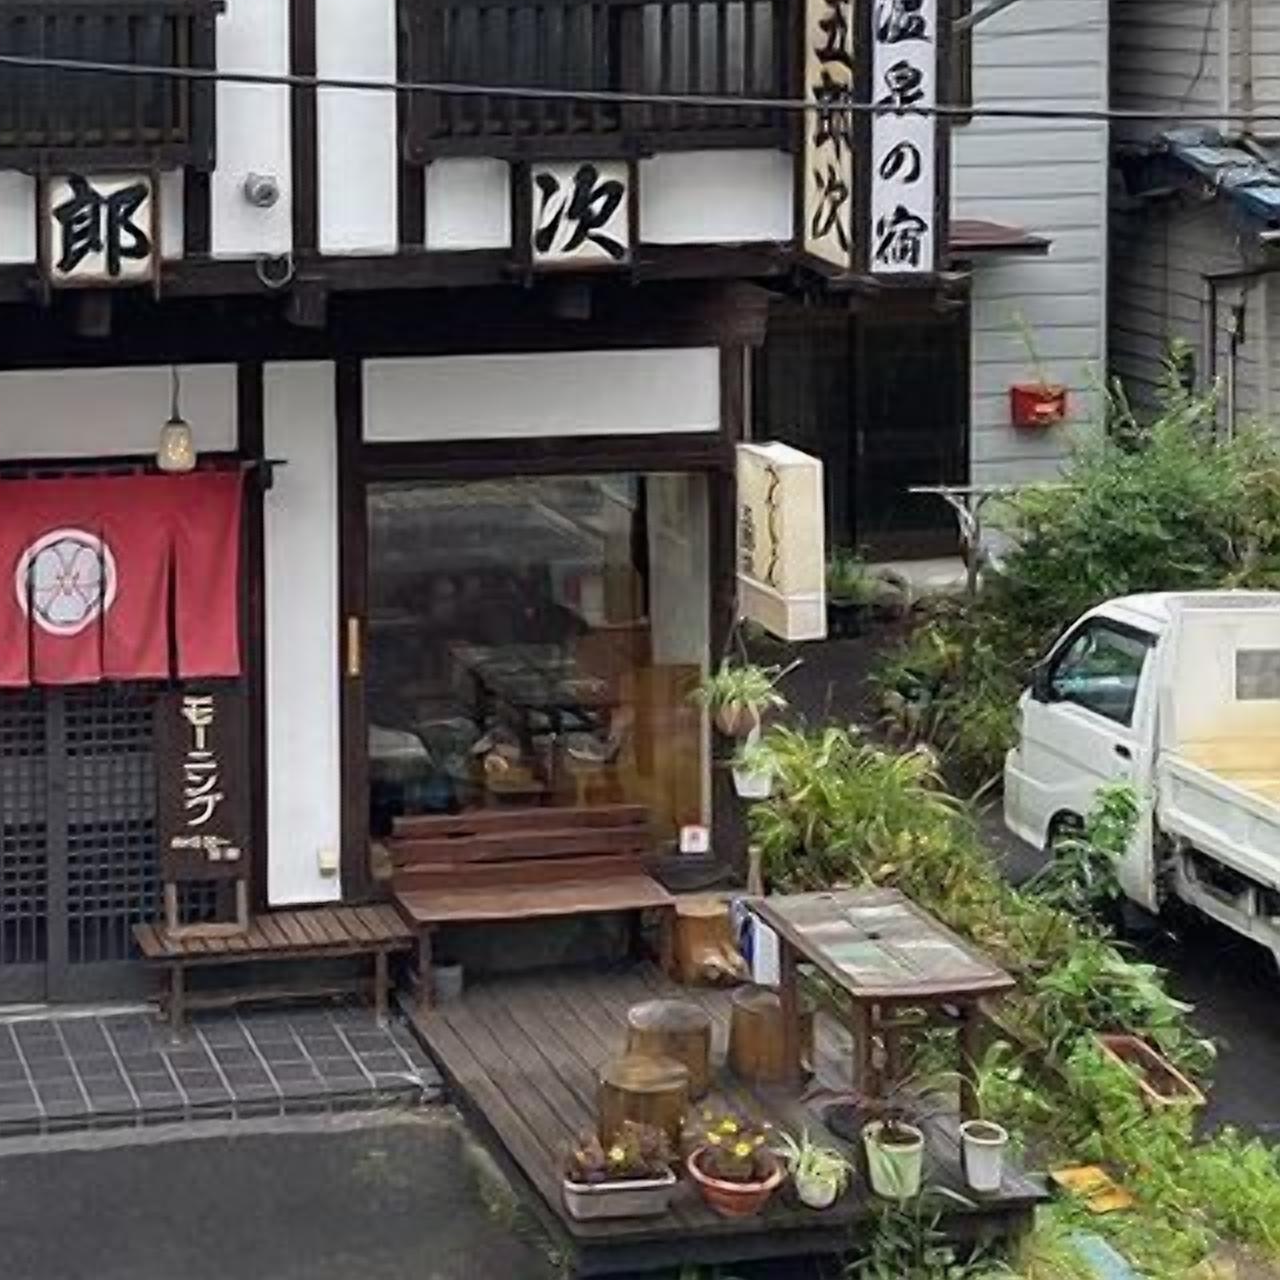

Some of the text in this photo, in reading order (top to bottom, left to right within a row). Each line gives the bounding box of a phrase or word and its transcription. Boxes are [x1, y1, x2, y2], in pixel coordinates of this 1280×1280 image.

[52, 172, 152, 276] 郎
[534, 163, 625, 260] 次
[181, 694, 223, 826] モーニング
